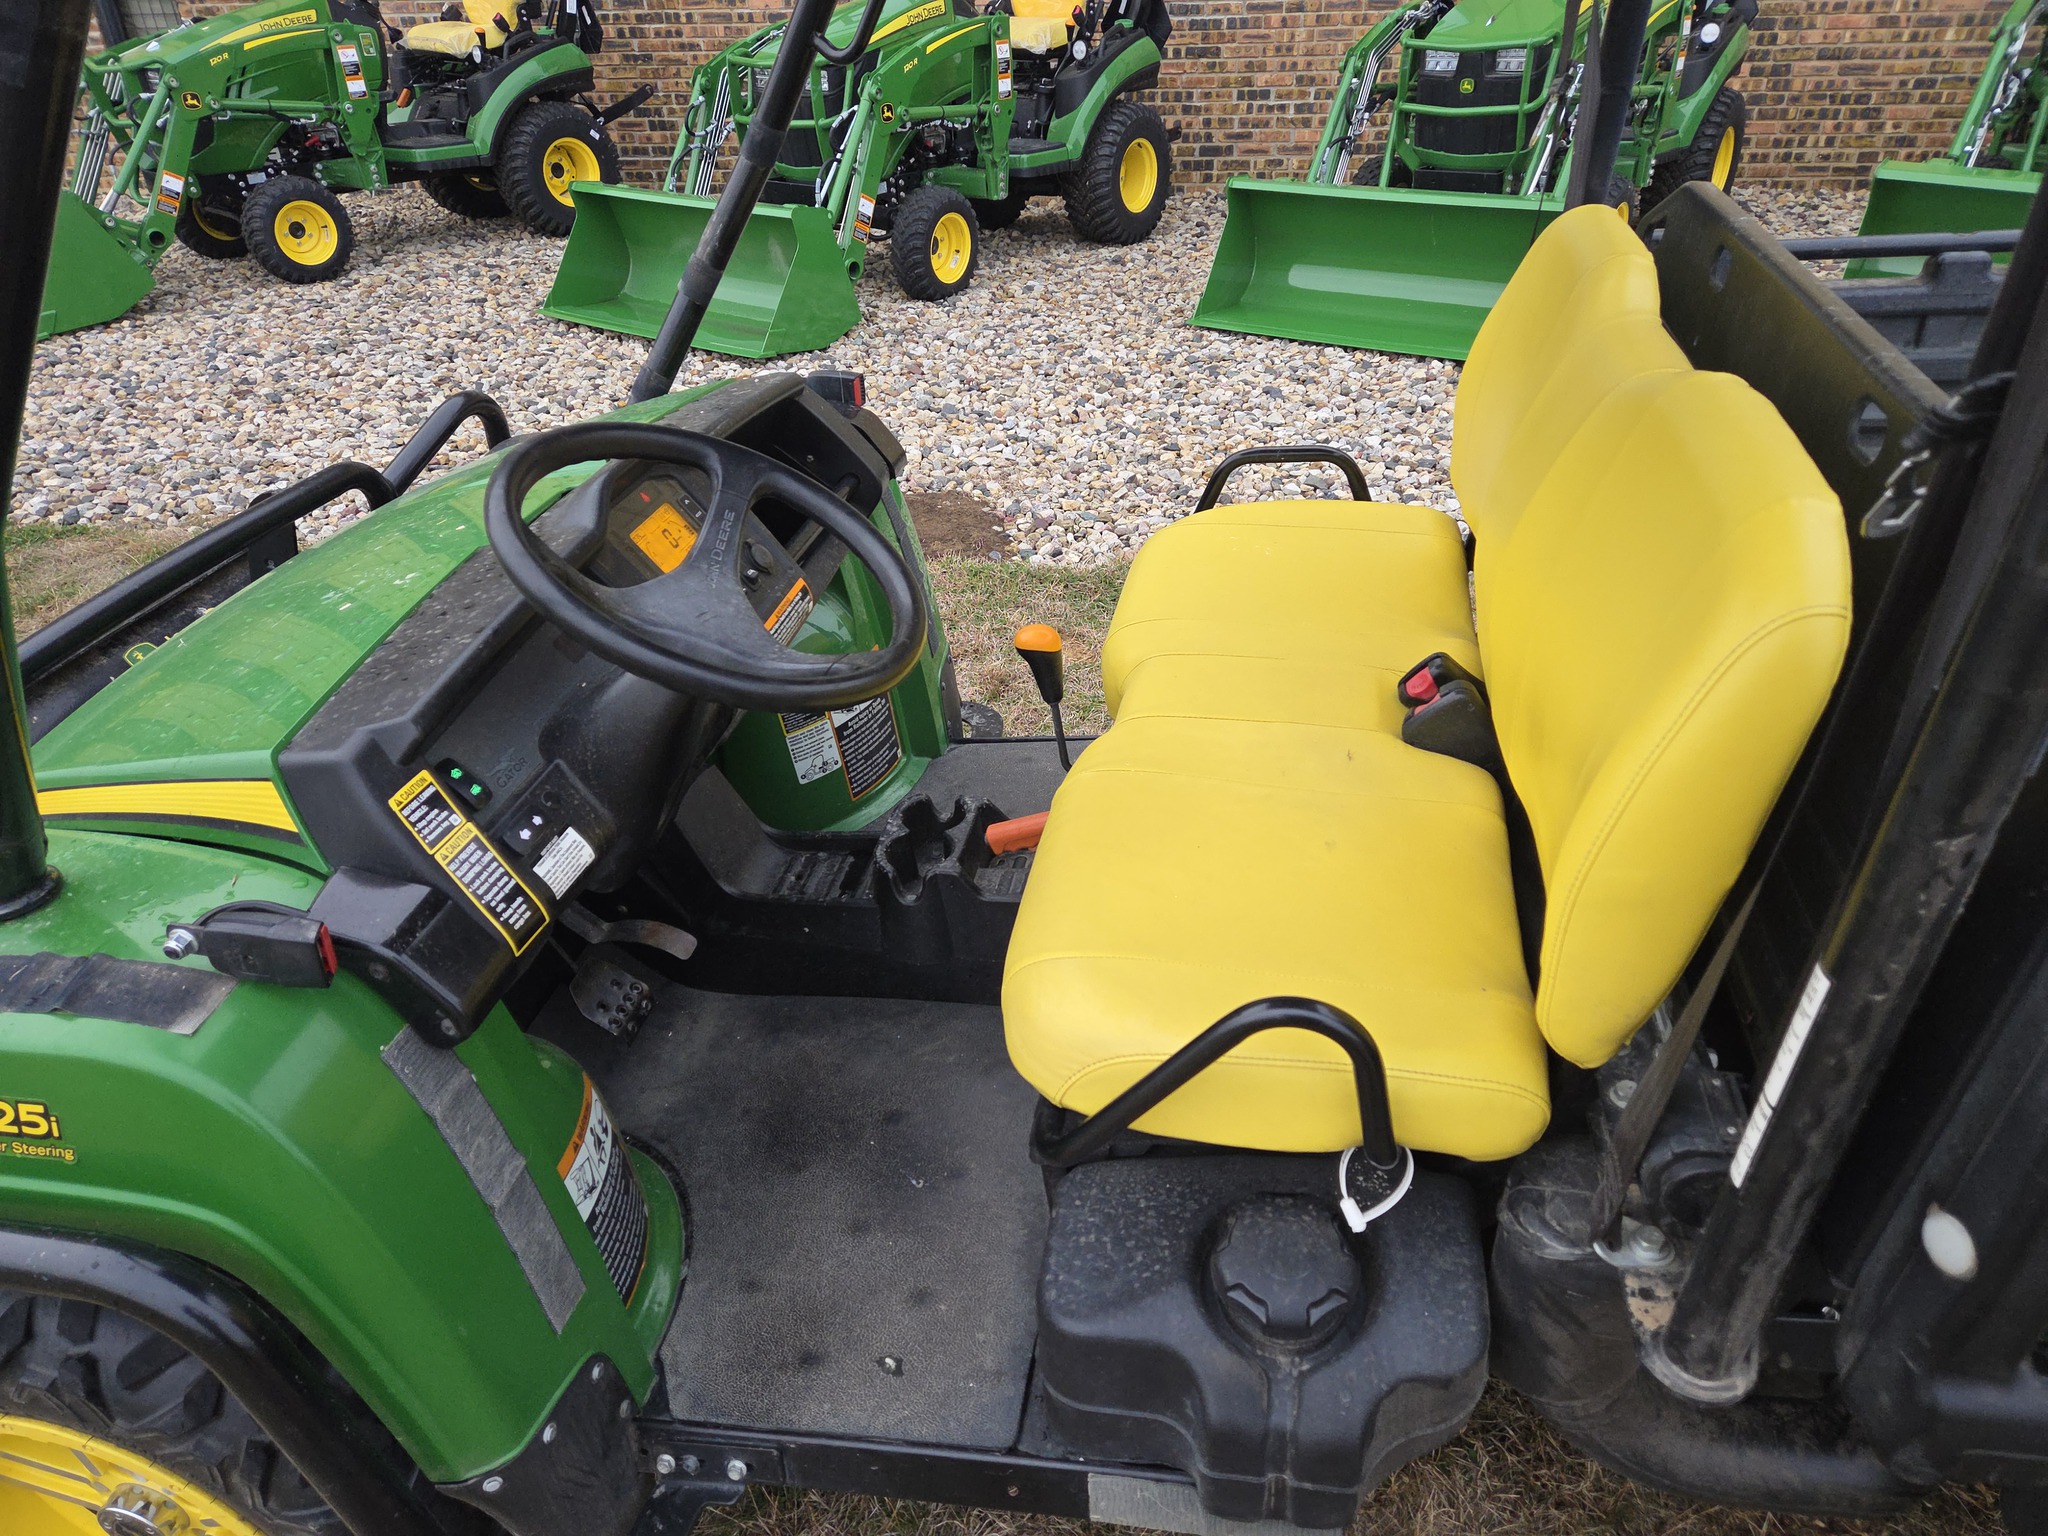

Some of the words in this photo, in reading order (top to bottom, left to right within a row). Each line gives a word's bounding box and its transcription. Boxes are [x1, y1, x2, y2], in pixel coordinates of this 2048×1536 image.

[260, 20, 282, 32] JOHN
[283, 14, 313, 26] DEERE
[906, 13, 923, 25] JOHN
[923, 5, 943, 19] DEERE
[710, 509, 735, 560] DEERE
[496, 757, 528, 788] GATOR
[400, 776, 428, 800] CAUTION
[446, 827, 473, 853] CAUTION
[12, 1142, 74, 1161] Steering
